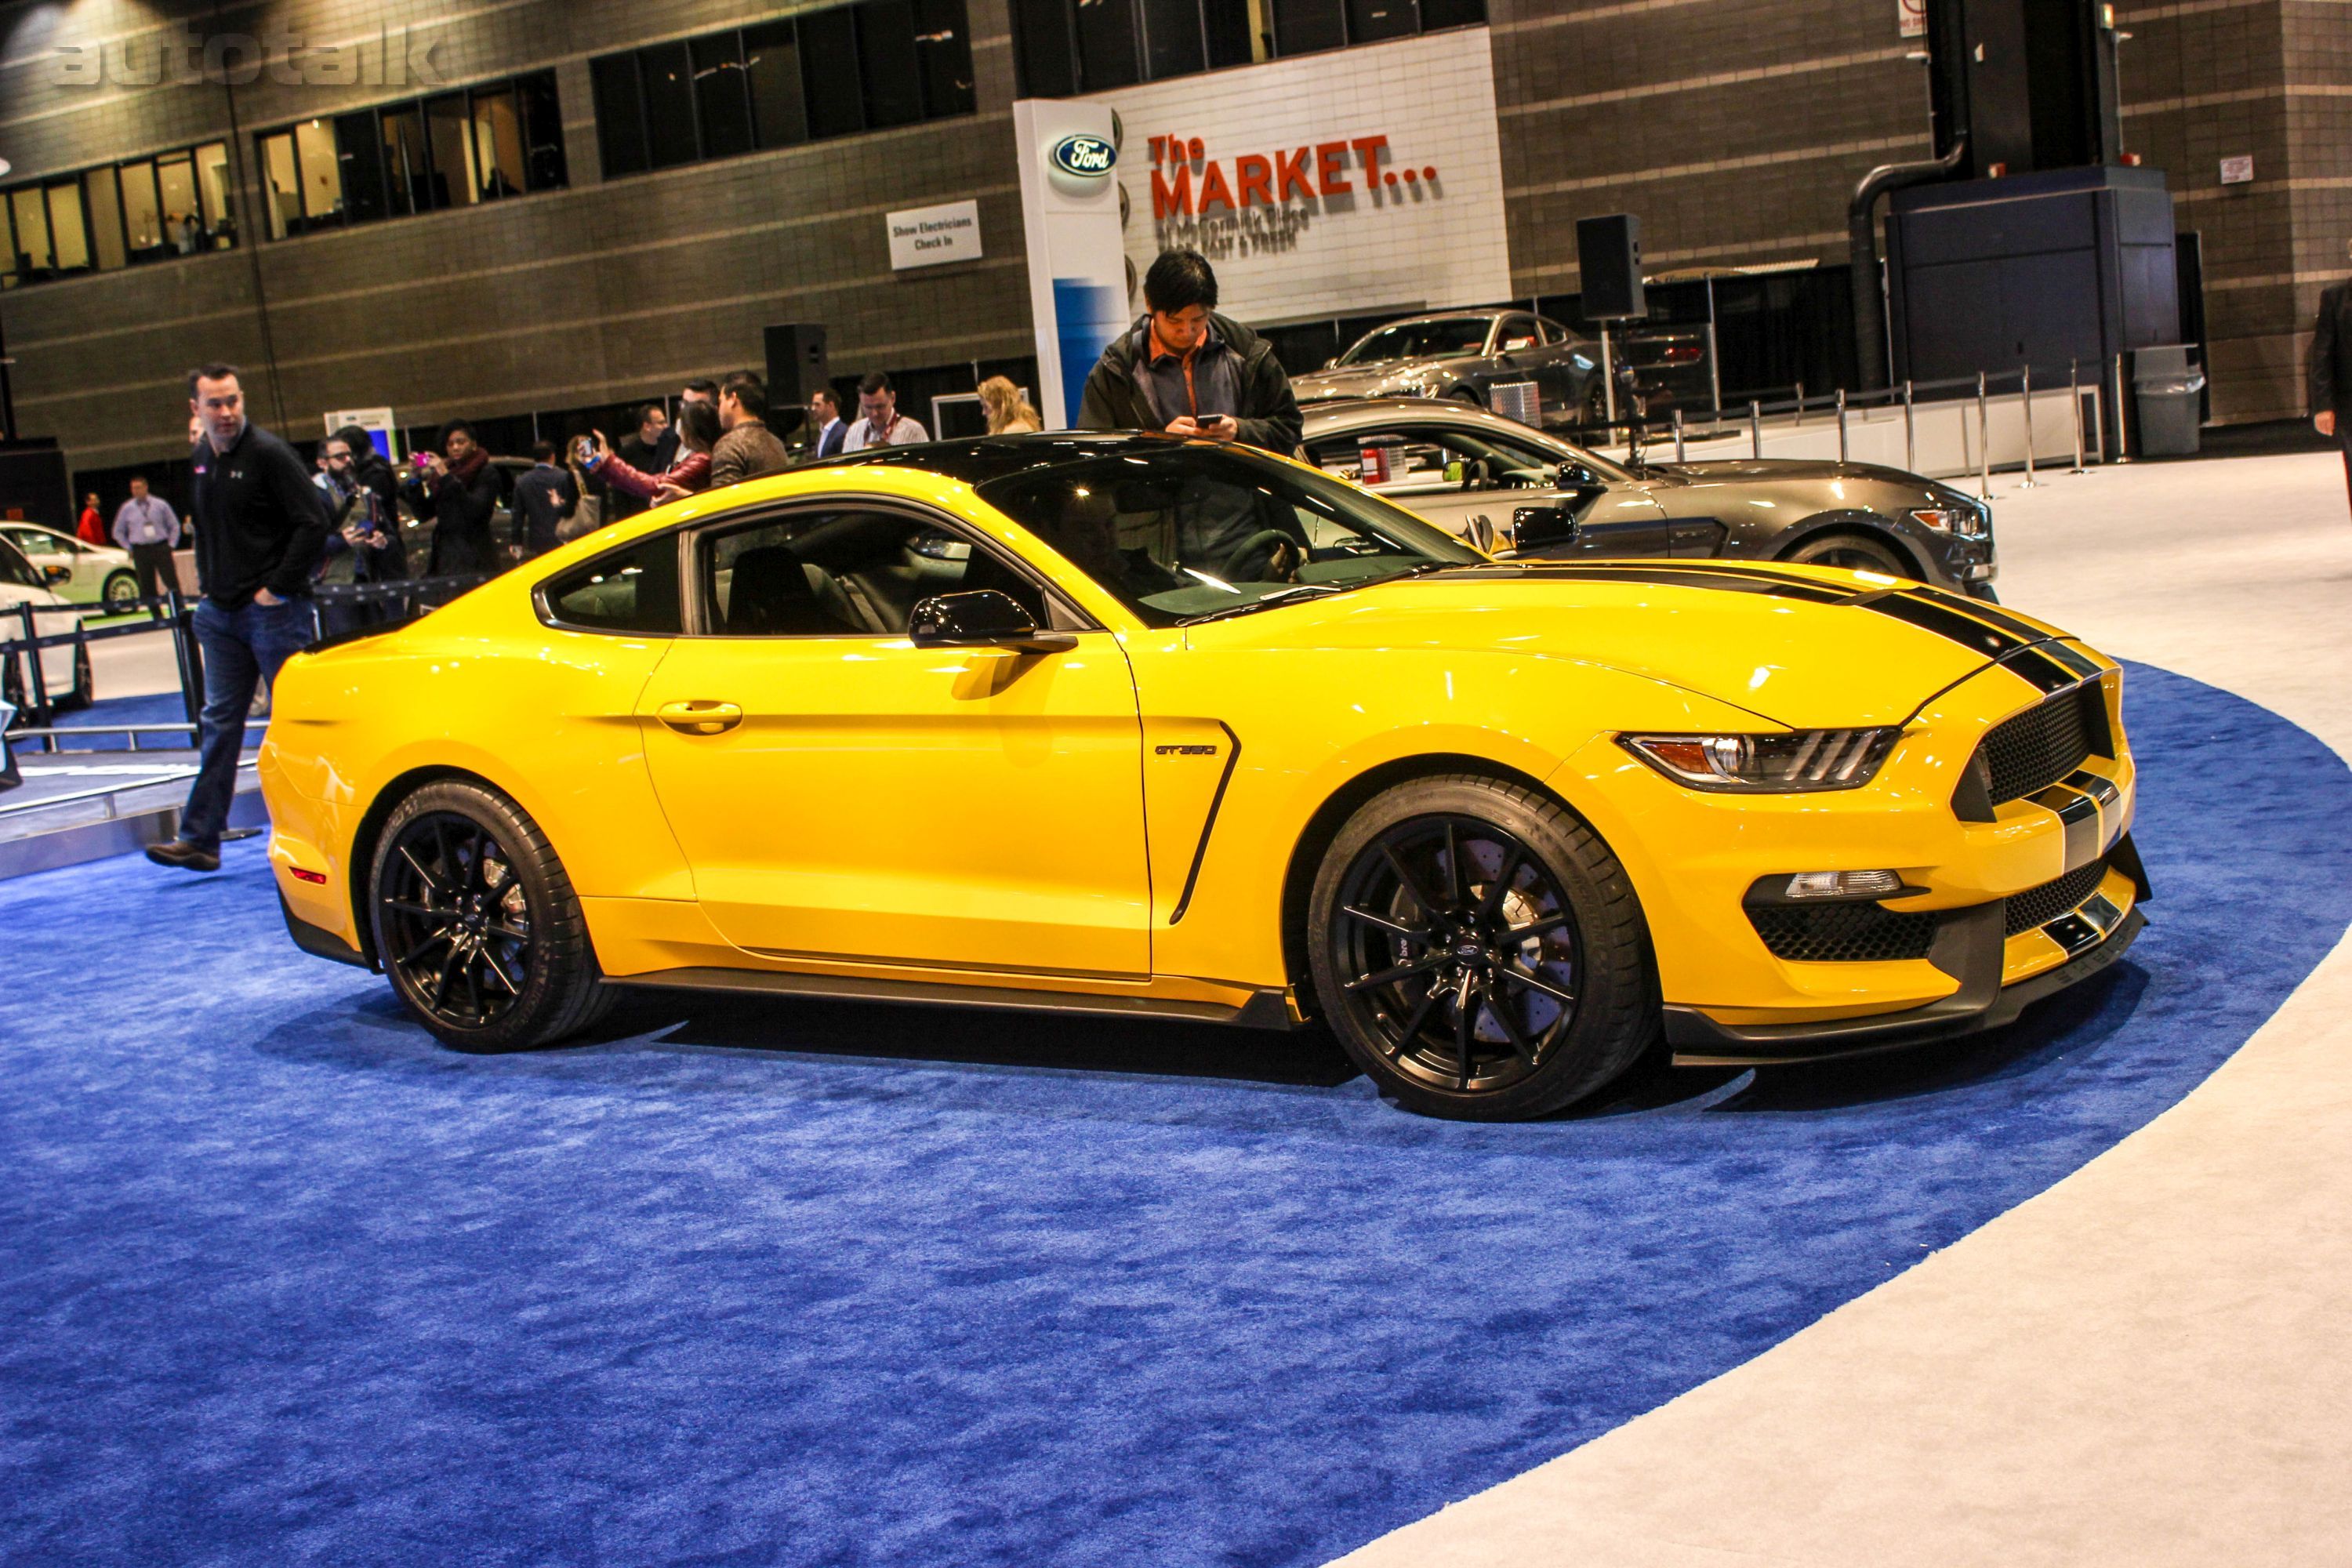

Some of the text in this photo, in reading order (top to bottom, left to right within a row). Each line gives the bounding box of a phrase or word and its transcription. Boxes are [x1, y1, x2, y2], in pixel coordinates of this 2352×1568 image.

[1071, 140, 1109, 169] Ford
[1148, 134, 1204, 166] The
[893, 217, 972, 238] Show Electricians
[914, 235, 953, 250] Check In
